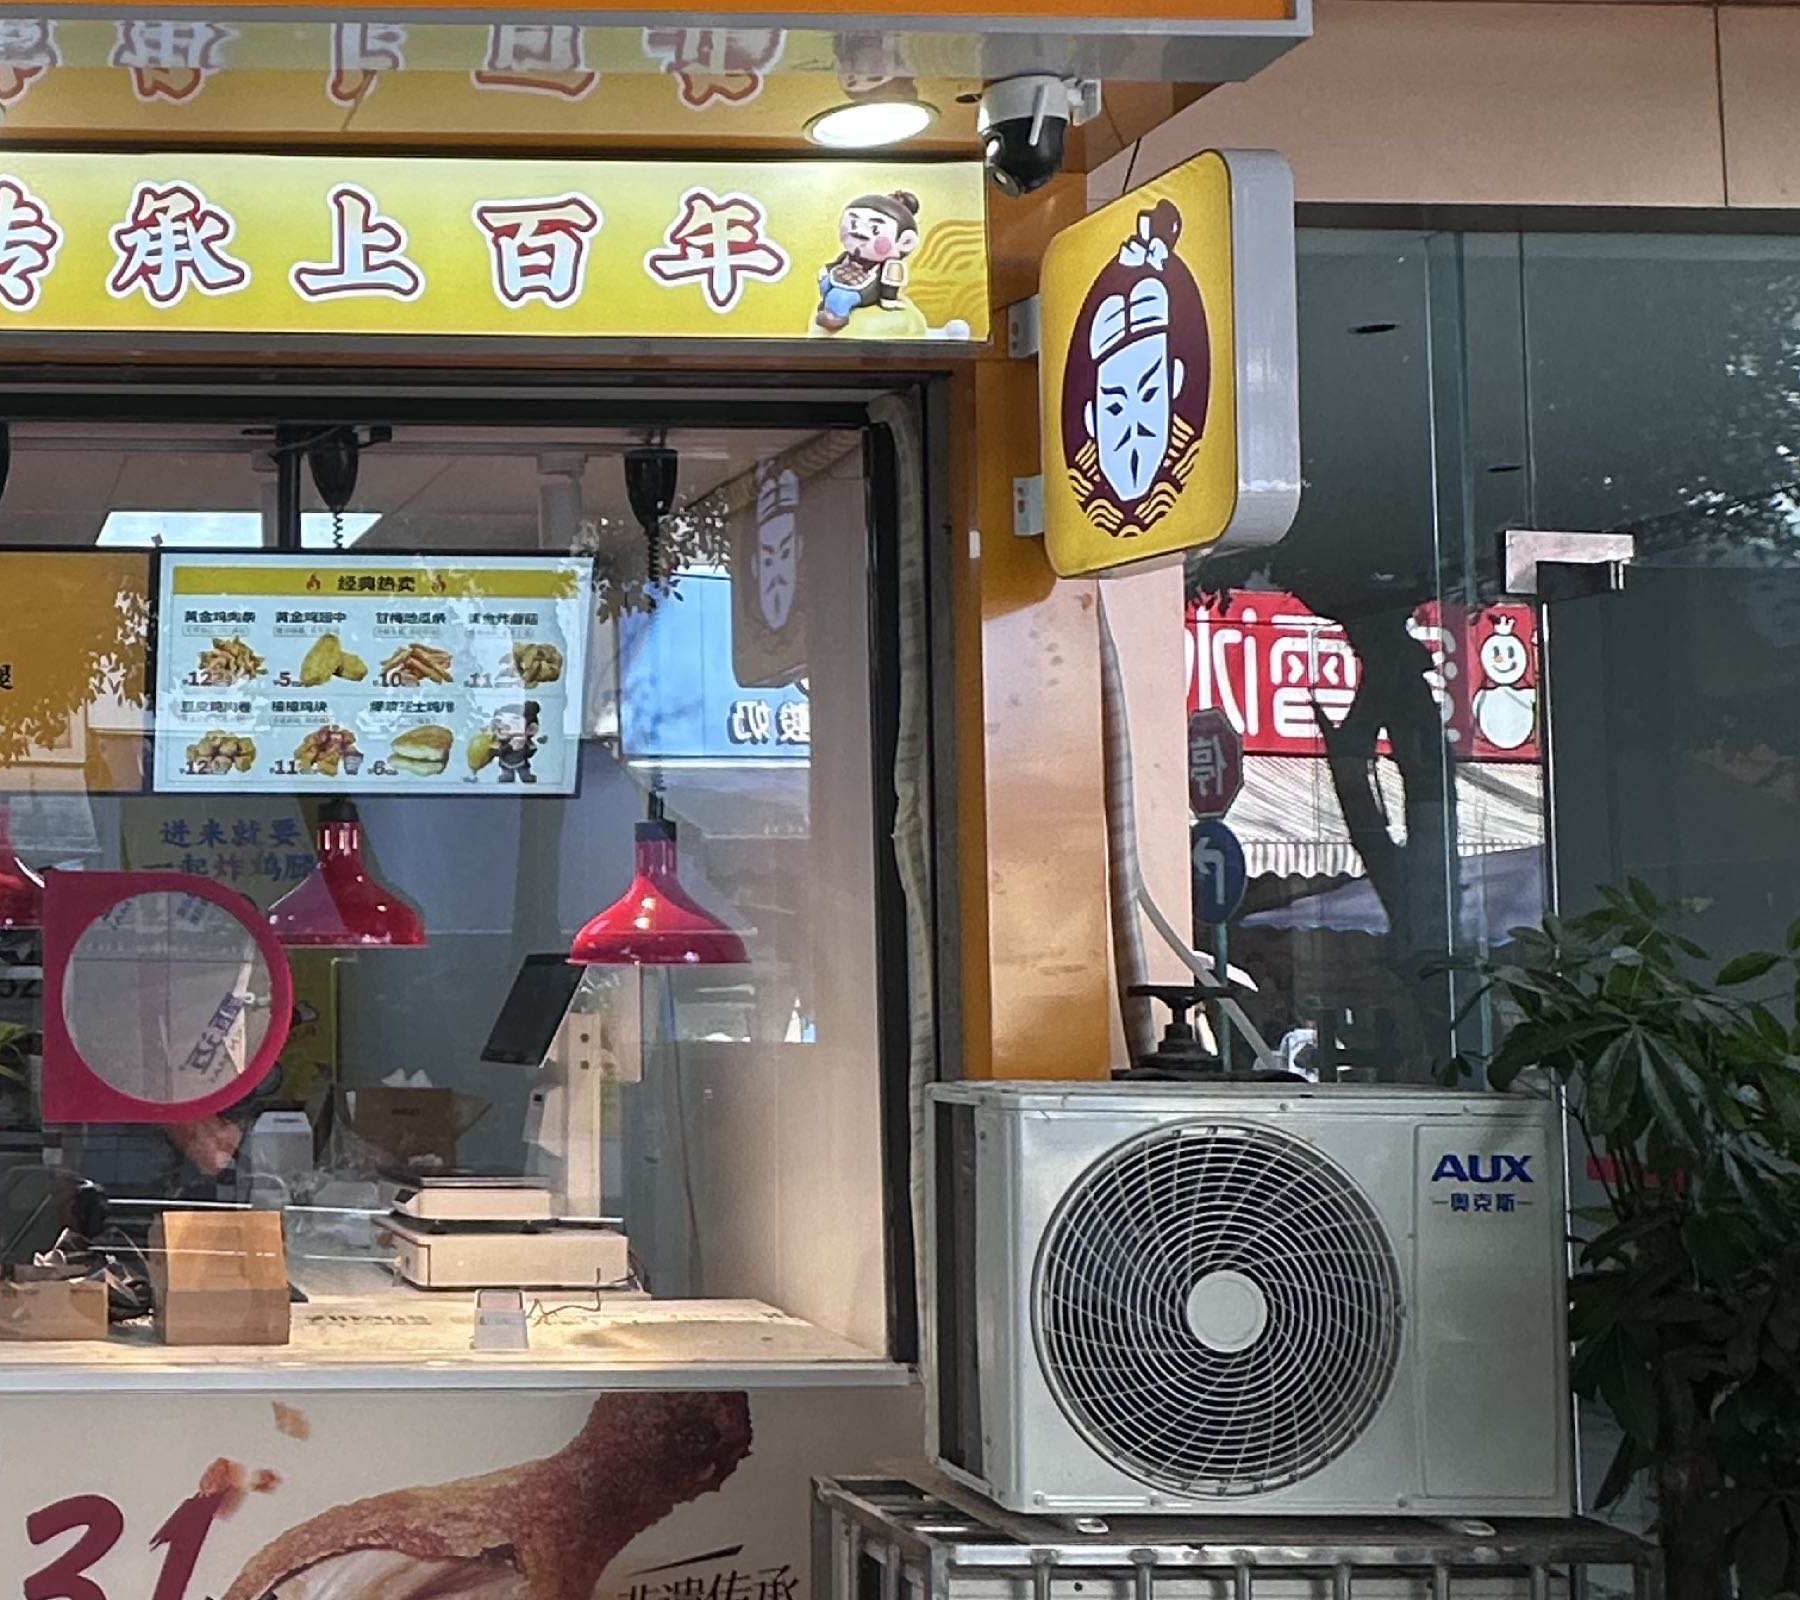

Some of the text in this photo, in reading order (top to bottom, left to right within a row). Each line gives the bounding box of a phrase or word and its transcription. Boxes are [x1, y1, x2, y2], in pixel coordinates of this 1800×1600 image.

[1431, 1153, 1535, 1184] AUX
[1450, 1192, 1518, 1214] 奥克斯
